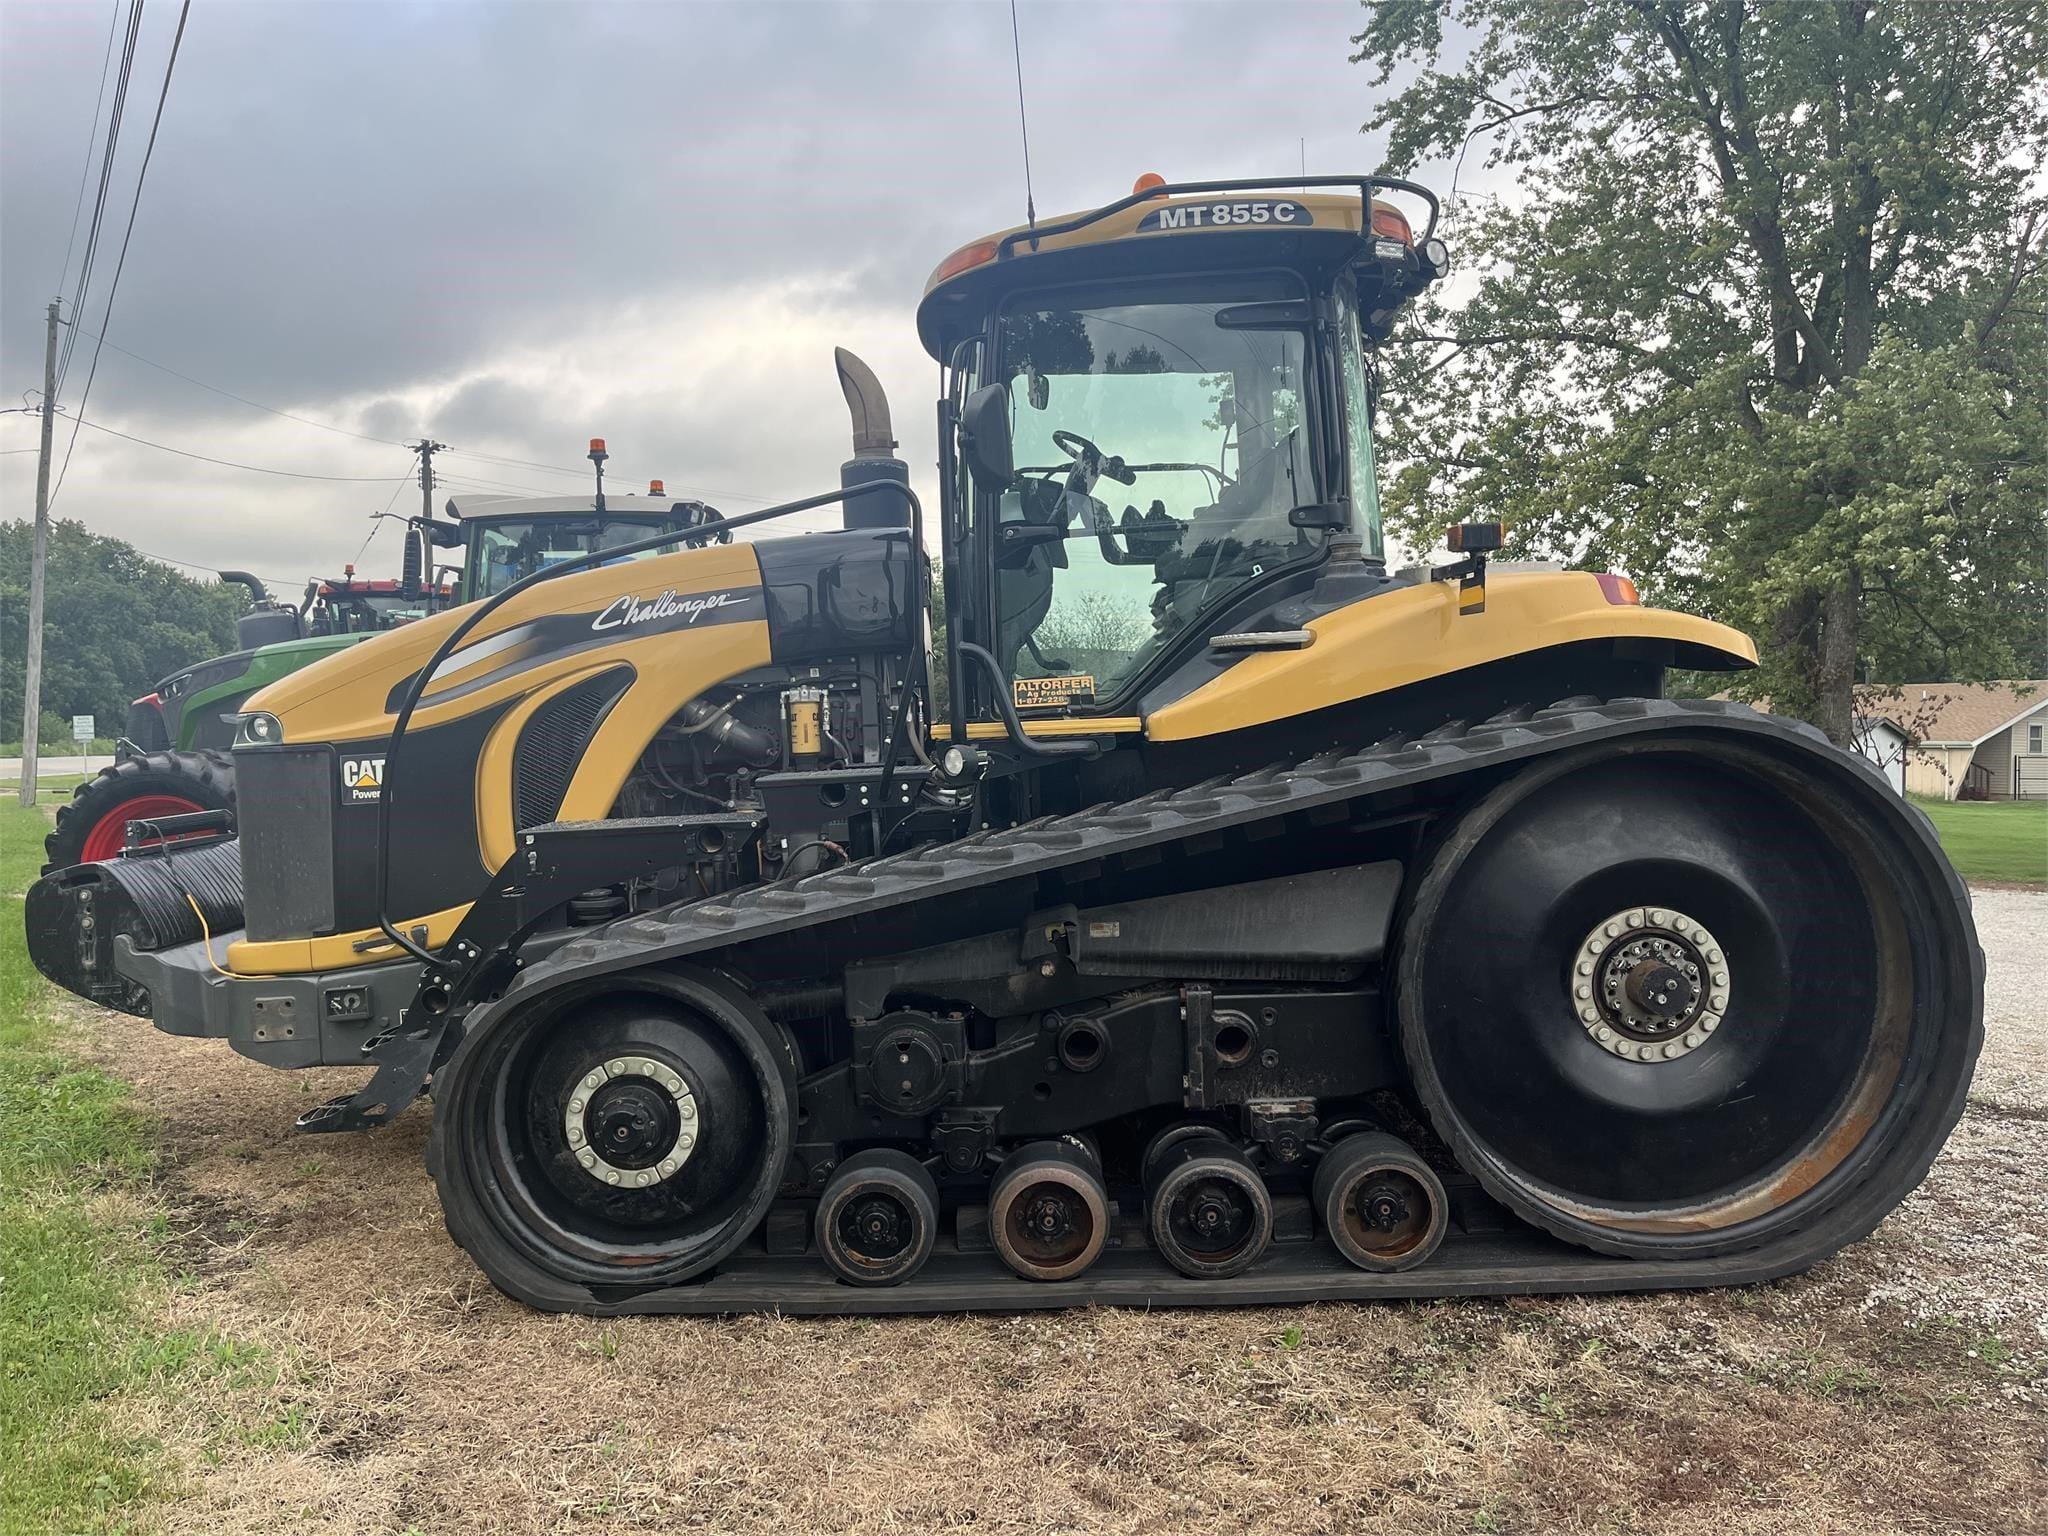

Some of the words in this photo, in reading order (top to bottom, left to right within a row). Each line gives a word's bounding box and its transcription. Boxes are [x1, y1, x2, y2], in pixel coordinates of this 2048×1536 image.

[1159, 206, 1207, 229] MT
[591, 589, 750, 631] Challenger
[1017, 679, 1091, 692] ALTORFER
[1027, 690, 1039, 698] Ag
[1041, 688, 1080, 697] Products
[343, 759, 386, 788] CAT
[352, 789, 381, 799] Power
